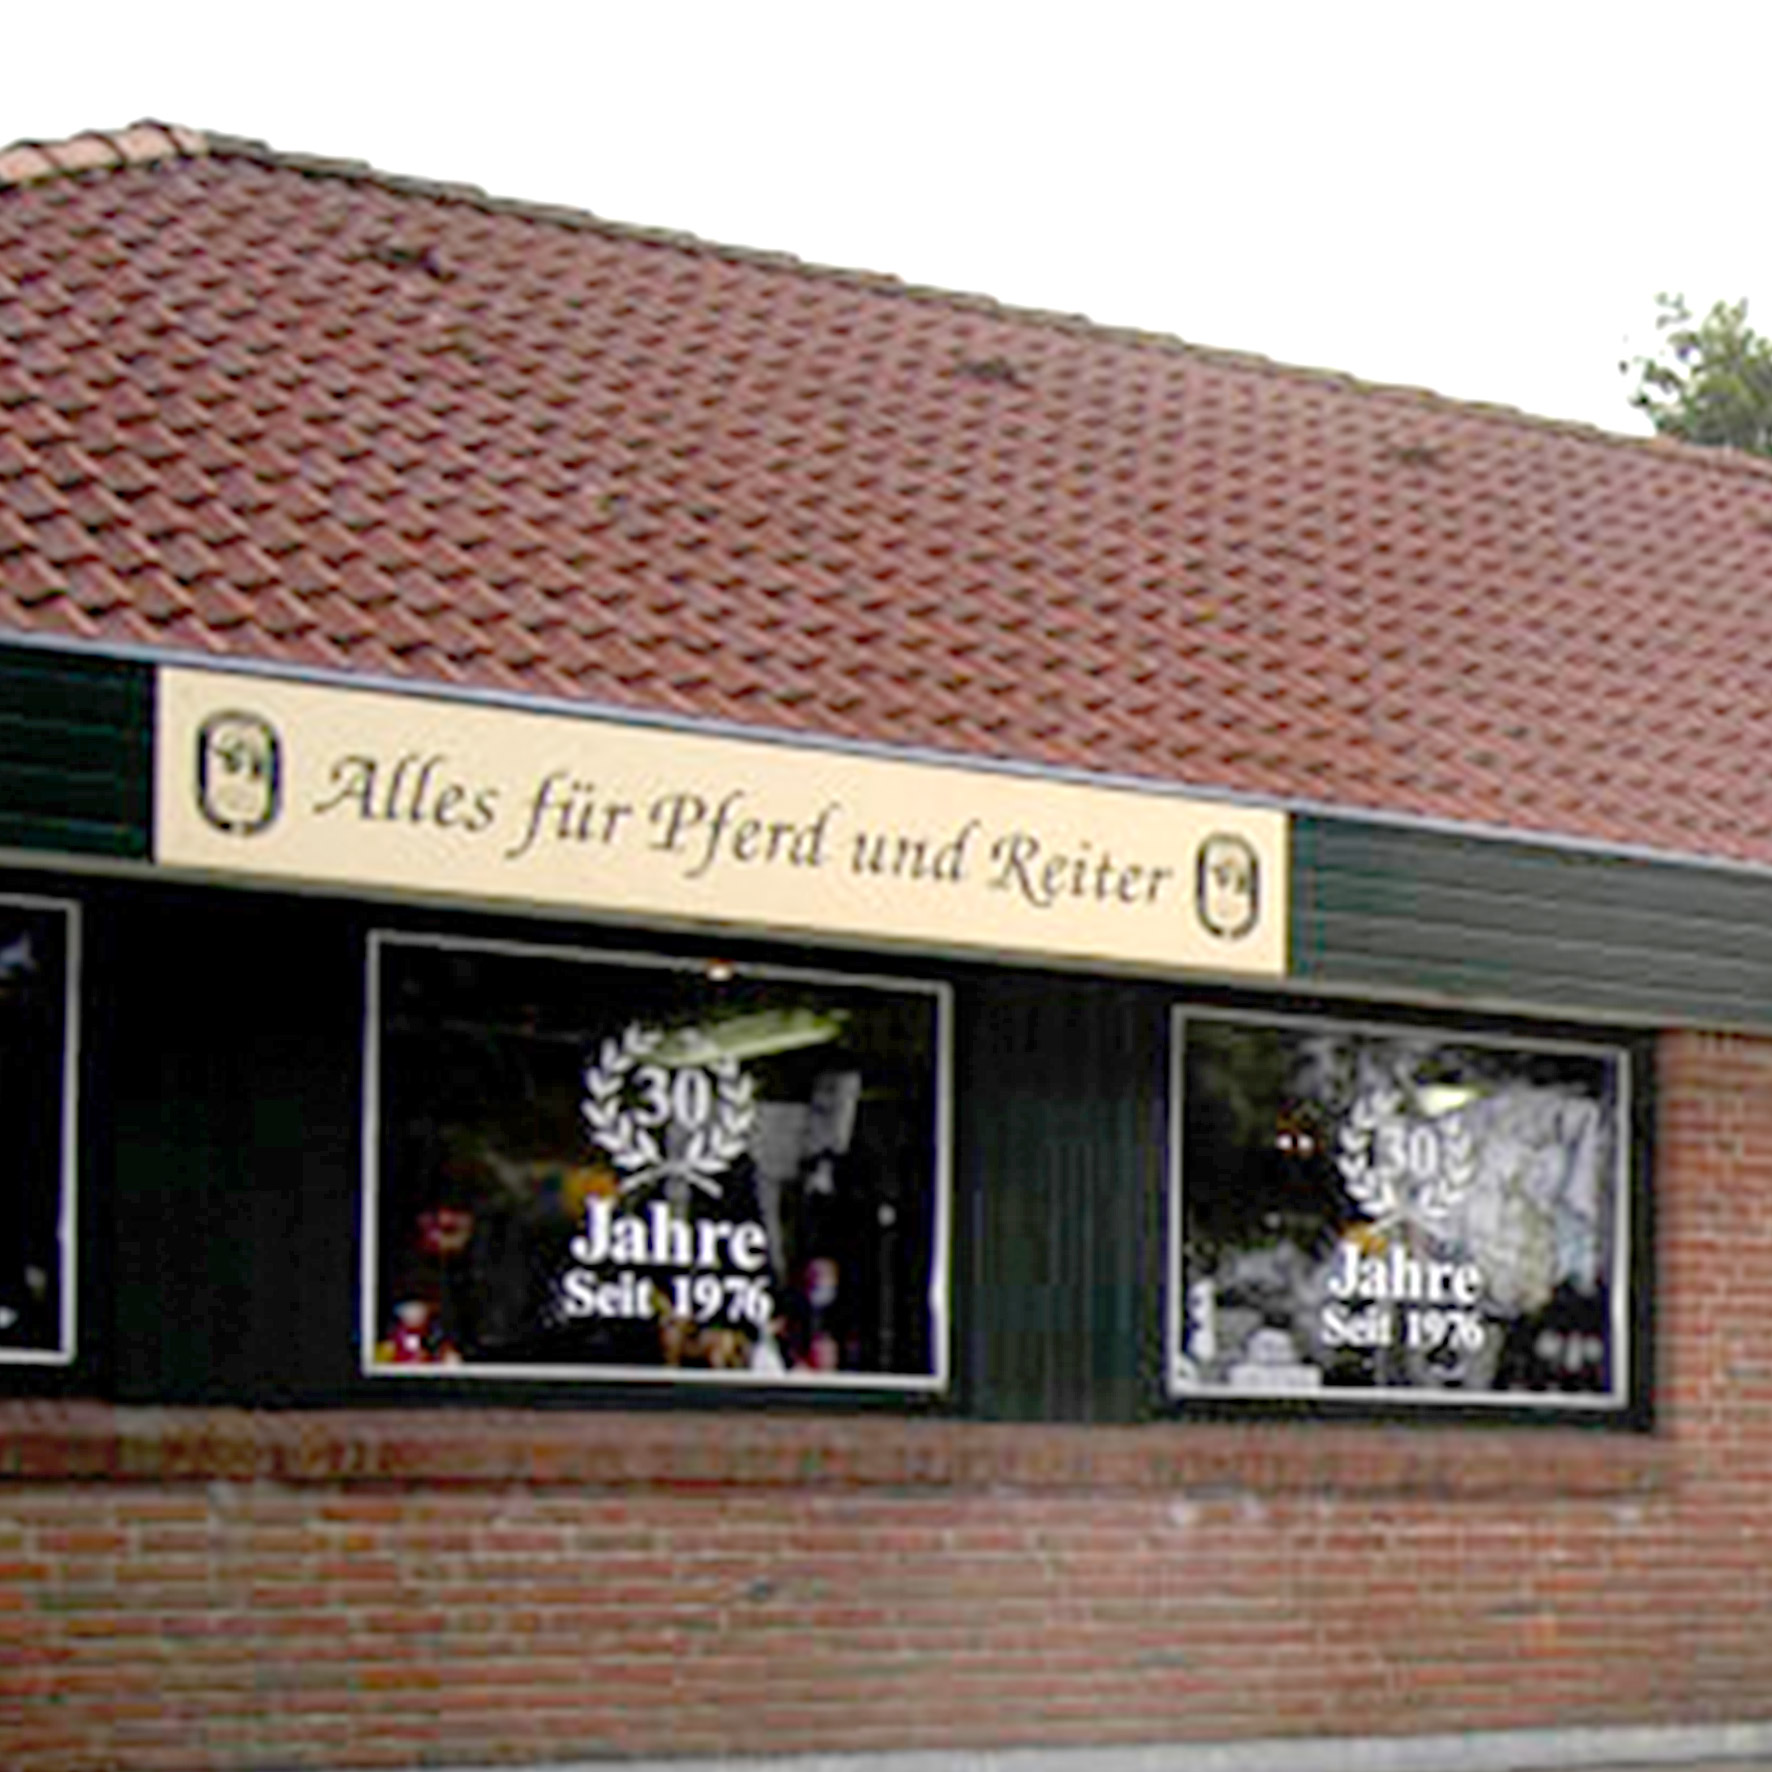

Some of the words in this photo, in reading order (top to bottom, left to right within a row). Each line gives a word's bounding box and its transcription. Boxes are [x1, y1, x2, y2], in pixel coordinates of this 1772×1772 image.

[313, 754, 500, 832] Alles
[504, 771, 633, 860] für
[647, 790, 842, 879] Pferd
[850, 819, 982, 883] und
[990, 829, 1175, 908] Reiter
[631, 1064, 713, 1131] 30
[1374, 1125, 1439, 1179] 30
[569, 1196, 768, 1271] Jahre
[561, 1267, 656, 1319] Seit
[671, 1272, 775, 1325] 1976
[1327, 1241, 1484, 1303] Jahre
[1320, 1302, 1394, 1346] Seit
[1404, 1307, 1487, 1352] 1976
